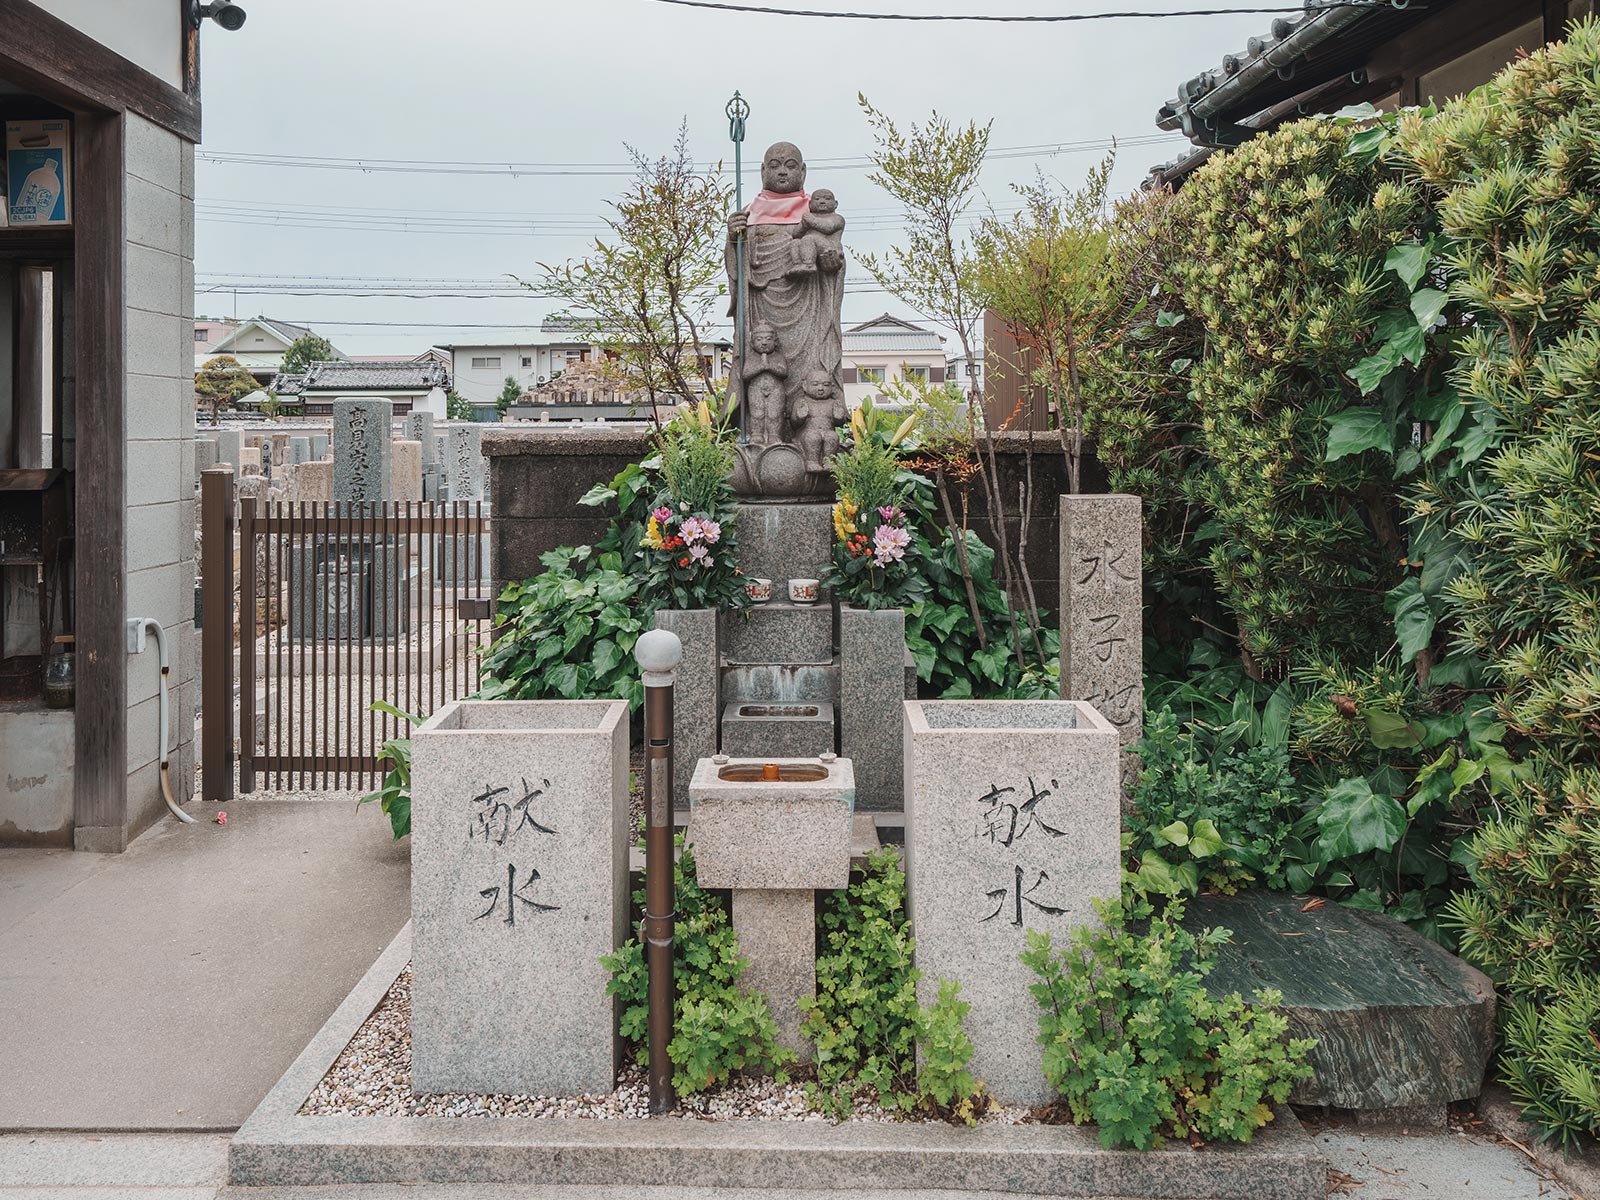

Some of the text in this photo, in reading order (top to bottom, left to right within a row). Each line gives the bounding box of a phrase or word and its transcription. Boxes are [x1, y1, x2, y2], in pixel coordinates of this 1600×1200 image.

[456, 428, 474, 498] 中井家之墓
[468, 776, 561, 927] 献水
[974, 776, 1071, 928] 献水
